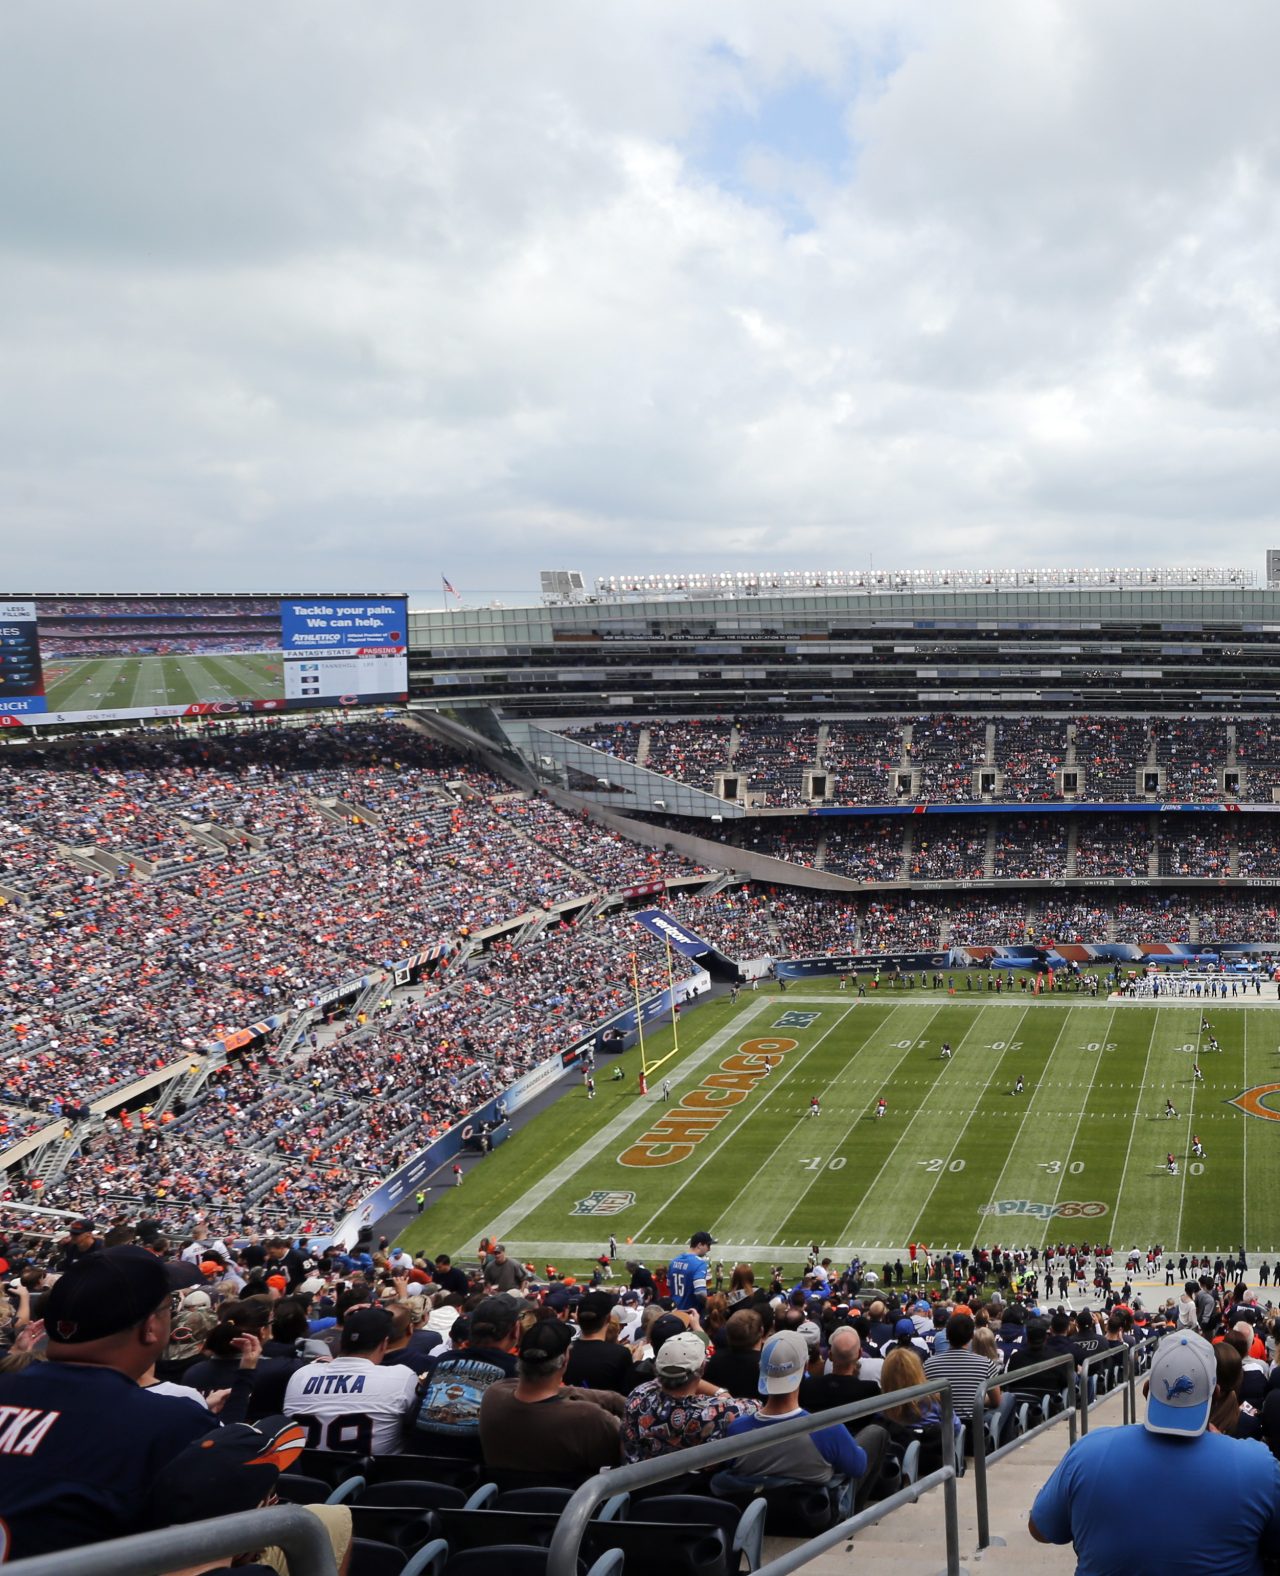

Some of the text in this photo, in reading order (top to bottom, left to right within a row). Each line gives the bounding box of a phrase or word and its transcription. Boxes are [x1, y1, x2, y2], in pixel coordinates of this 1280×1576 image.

[292, 606, 396, 616] Tackle your pain.
[306, 618, 384, 627] We can help.
[651, 917, 693, 943] verizon
[340, 981, 361, 997] DOWN
[616, 1037, 799, 1168] CHICAGO
[803, 1157, 848, 1170] 10
[925, 1159, 967, 1173] 20
[1046, 1161, 1086, 1174] 30
[673, 1273, 685, 1297] 15
[302, 1375, 366, 1395] DITKA
